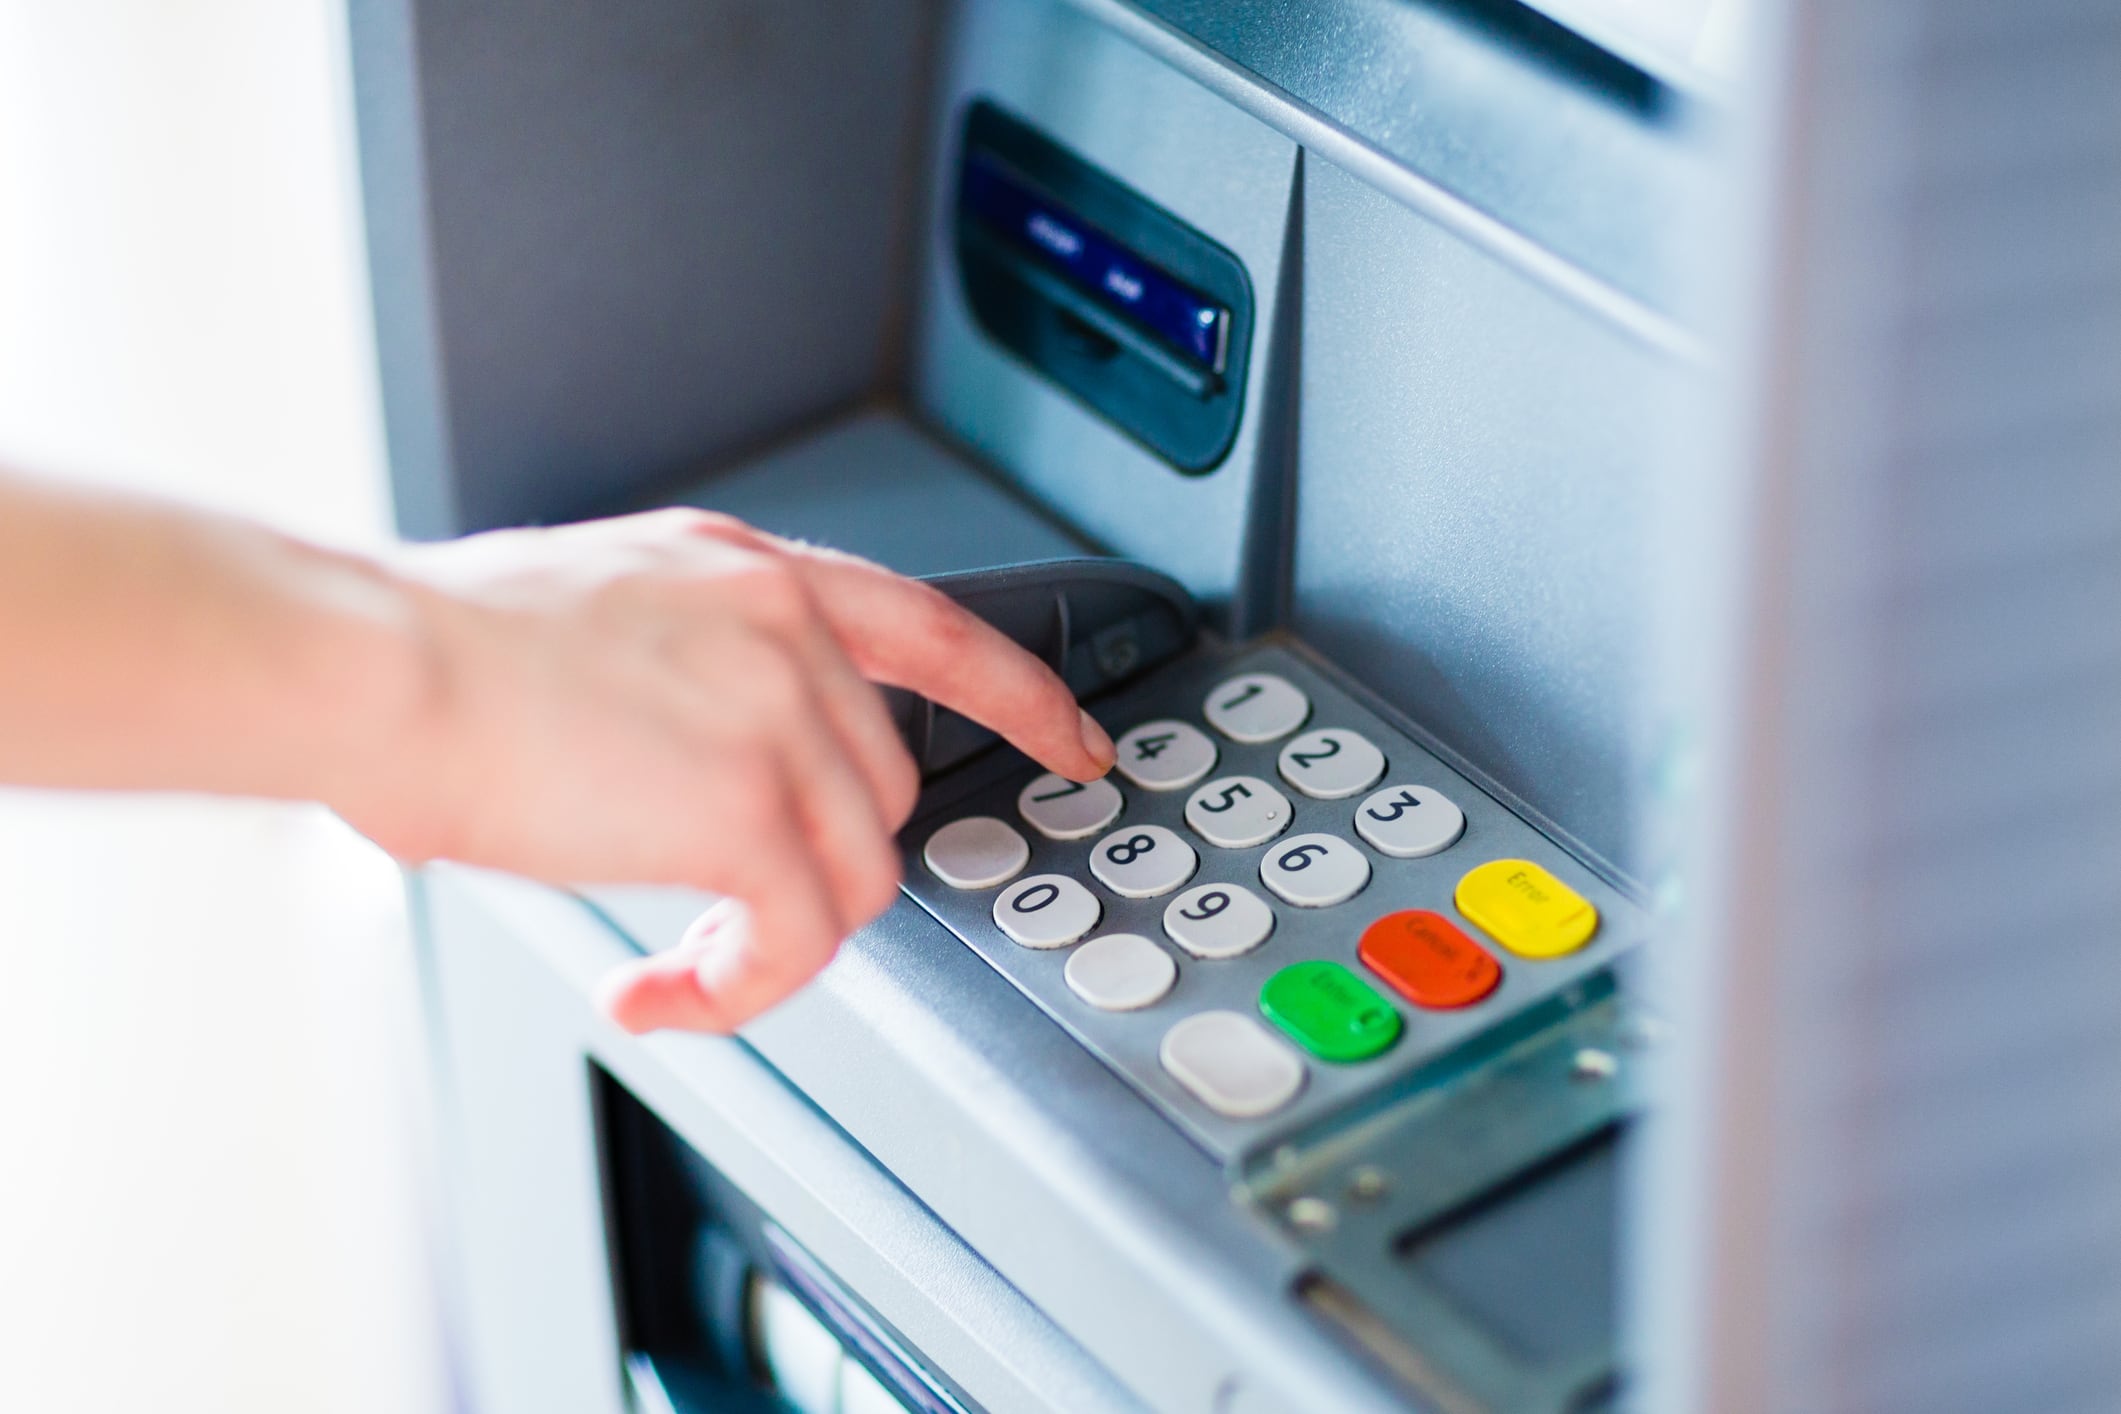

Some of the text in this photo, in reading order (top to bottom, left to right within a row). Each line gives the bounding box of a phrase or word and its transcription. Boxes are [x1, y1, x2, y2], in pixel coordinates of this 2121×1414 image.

[1221, 683, 1264, 711] 1
[1134, 732, 1178, 761] 4
[1290, 737, 1342, 769] 2
[1198, 782, 1253, 814] 5
[1366, 789, 1422, 823] 3
[1106, 833, 1156, 866] 8
[1277, 843, 1329, 873] 6
[1011, 883, 1060, 913] 0
[1178, 891, 1231, 921] 9
